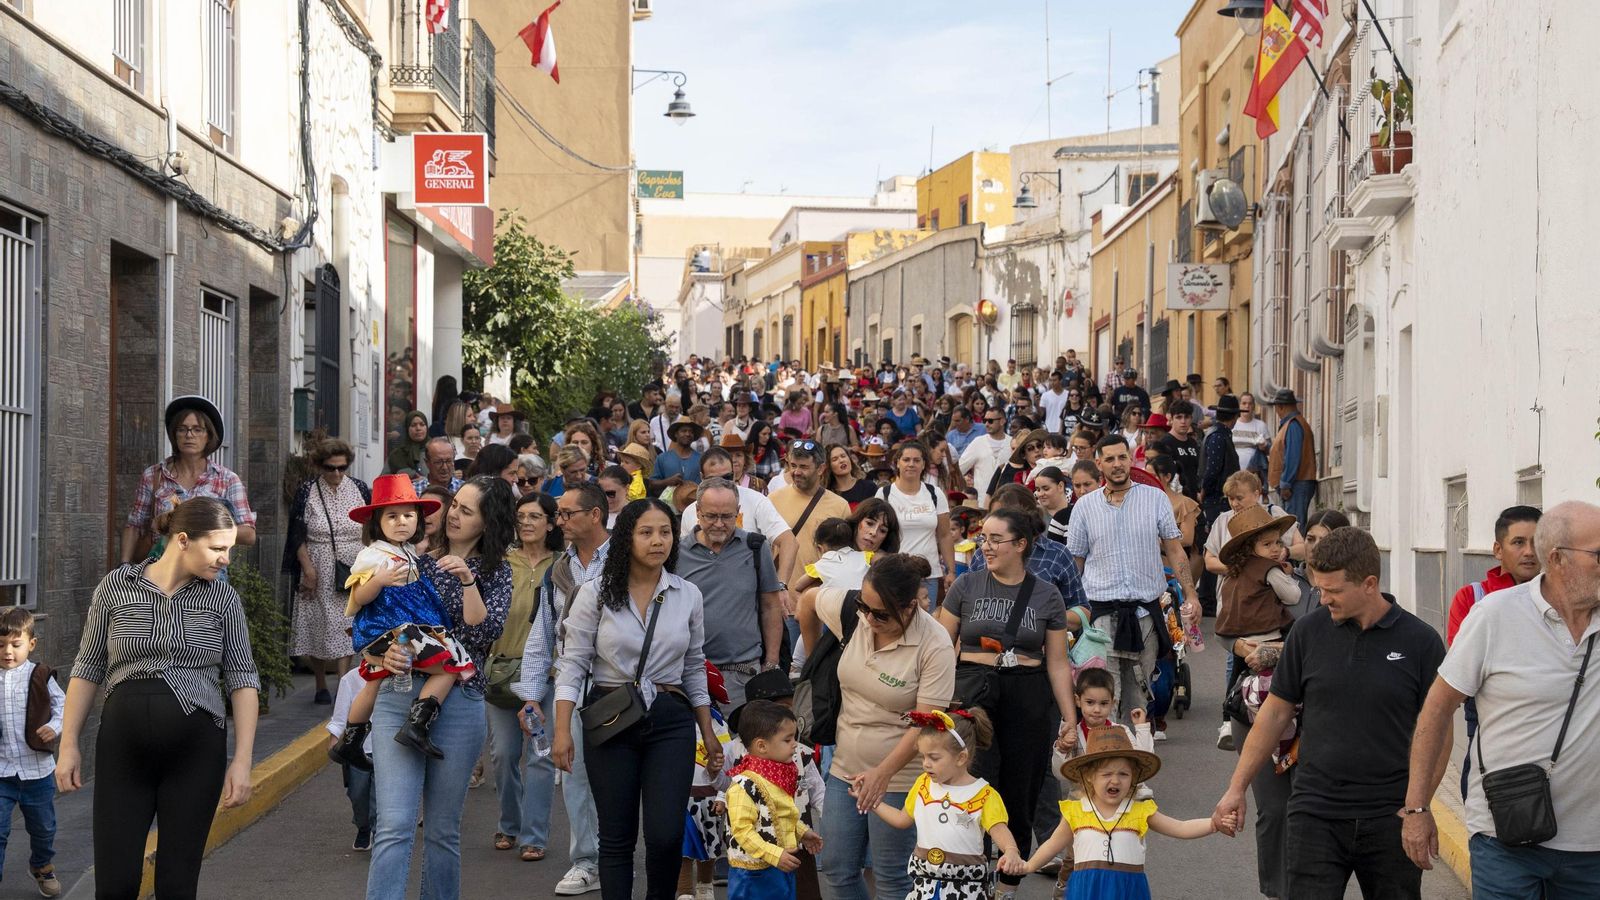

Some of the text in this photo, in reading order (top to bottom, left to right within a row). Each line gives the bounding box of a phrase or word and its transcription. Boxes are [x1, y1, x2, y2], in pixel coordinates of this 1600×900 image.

[424, 179, 475, 189] GENERALI
[638, 171, 682, 188] Caprichos
[654, 185, 676, 198] Eva
[970, 597, 1037, 632] BROOKN
